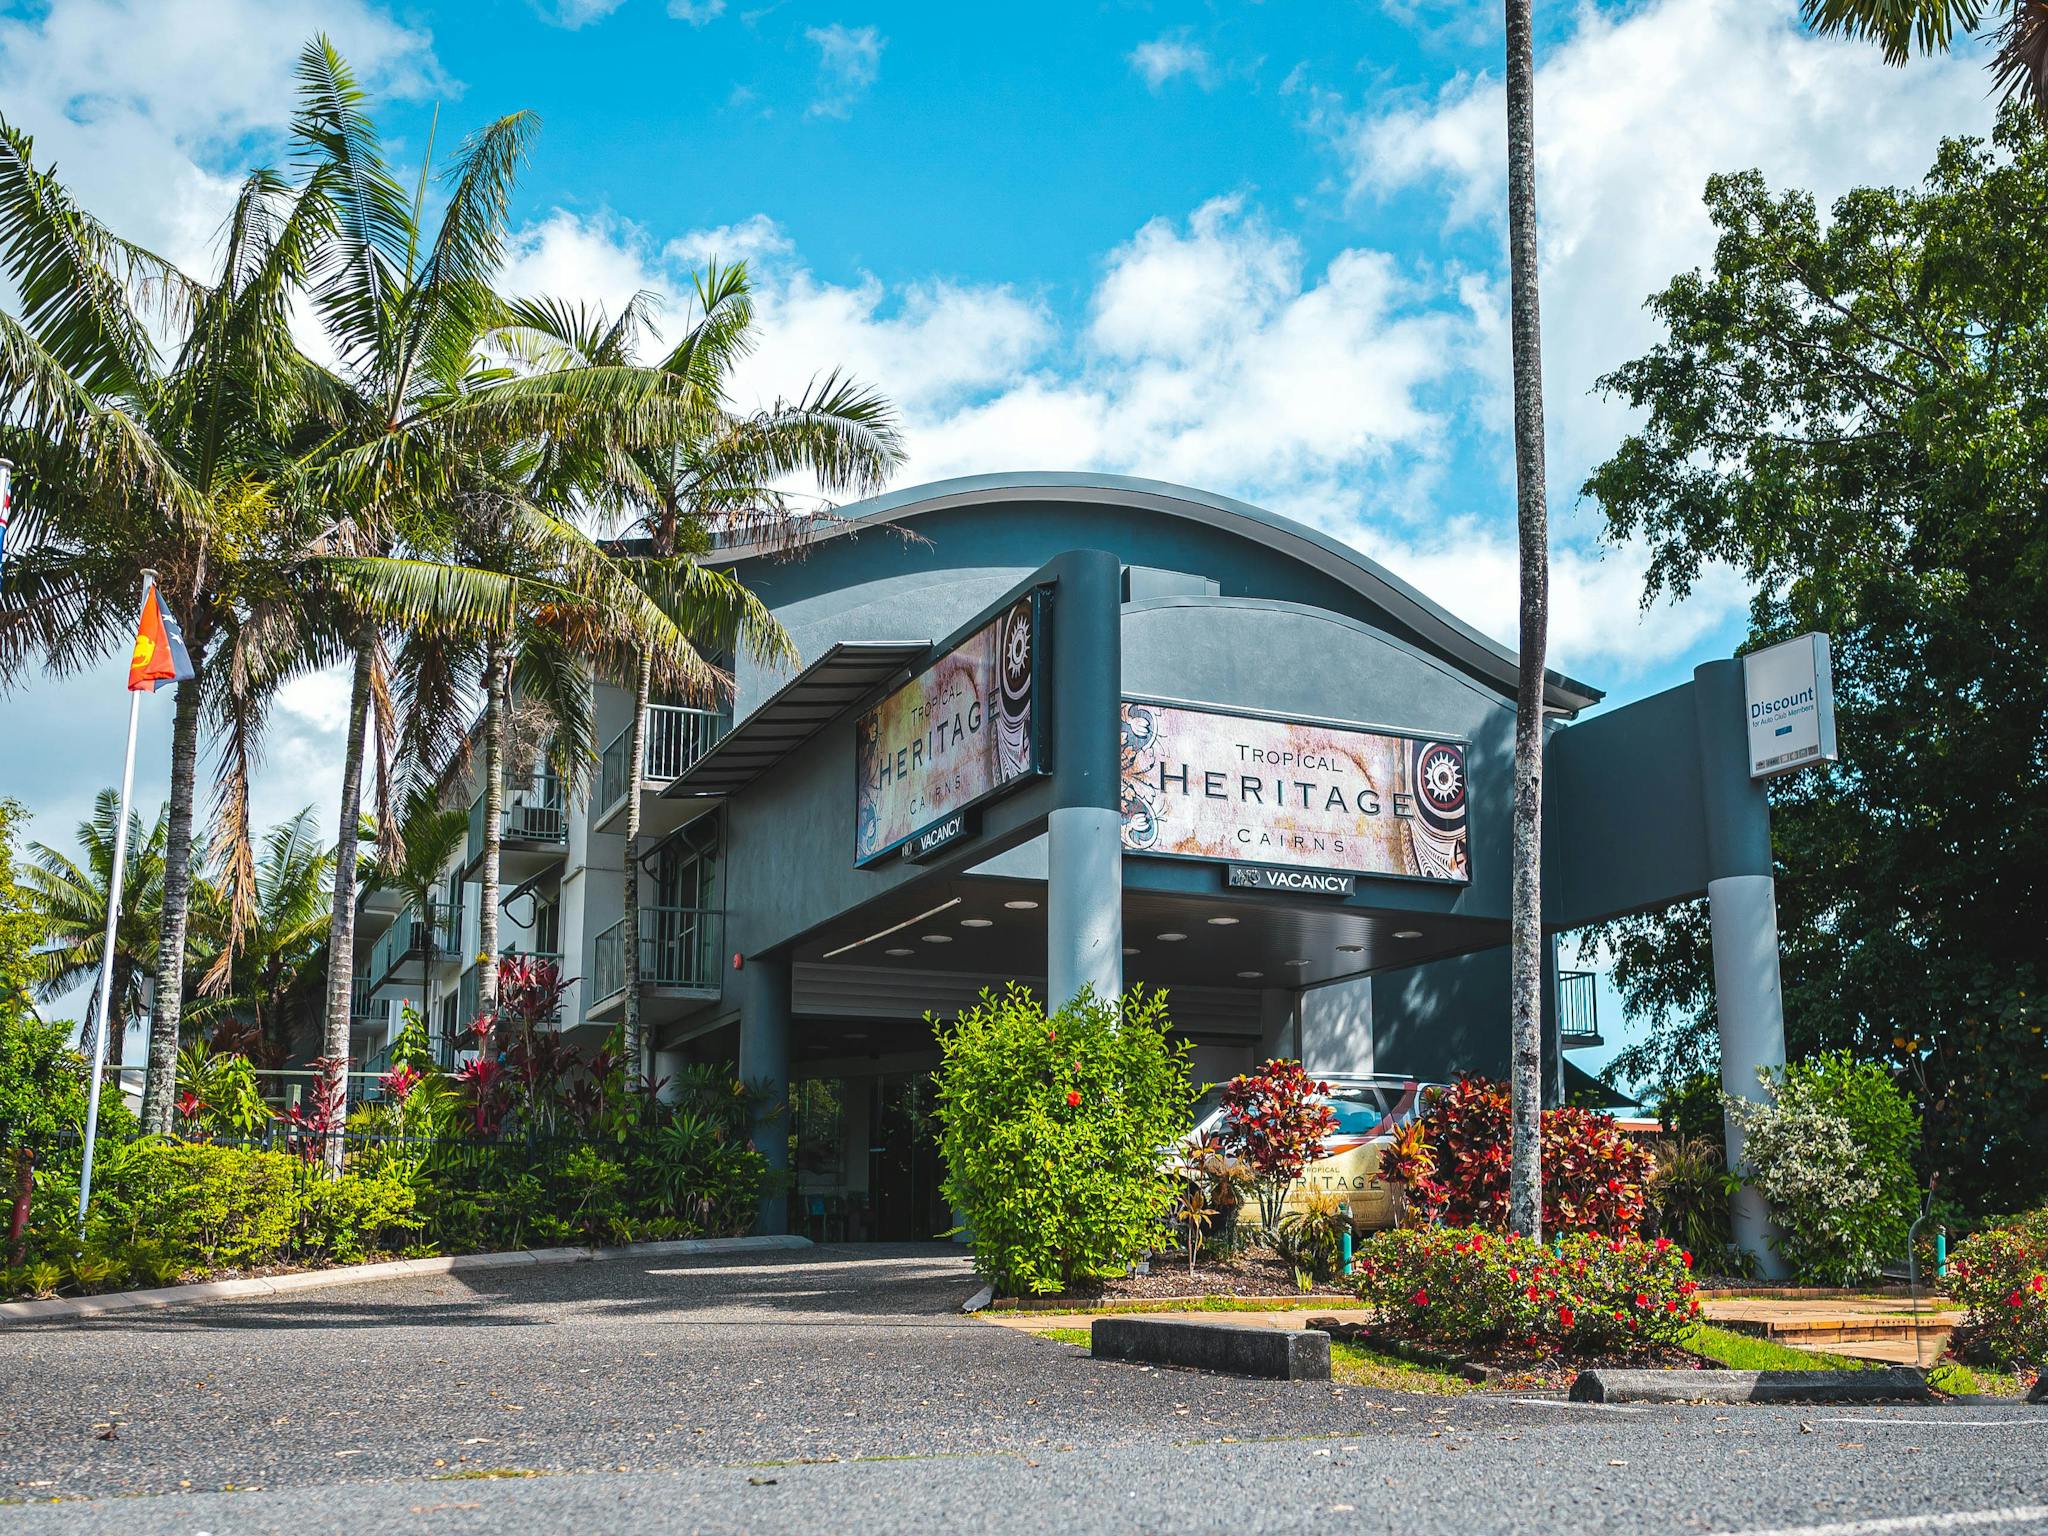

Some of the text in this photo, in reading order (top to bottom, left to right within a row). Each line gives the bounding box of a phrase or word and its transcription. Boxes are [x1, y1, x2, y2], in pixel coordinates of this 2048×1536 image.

[911, 685, 962, 727] TROPICAL
[1751, 687, 1813, 718] Discount
[1752, 704, 1813, 728] for Auto Club Members
[879, 687, 1001, 789] HERITAGE
[1235, 743, 1344, 774] TROPICAL
[1159, 761, 1415, 819] HERITAGE
[920, 816, 960, 850] VACANCY
[1236, 828, 1345, 853] CAIRNS
[1265, 871, 1348, 892] VACANCY
[1306, 1166, 1341, 1174] ROPICAL
